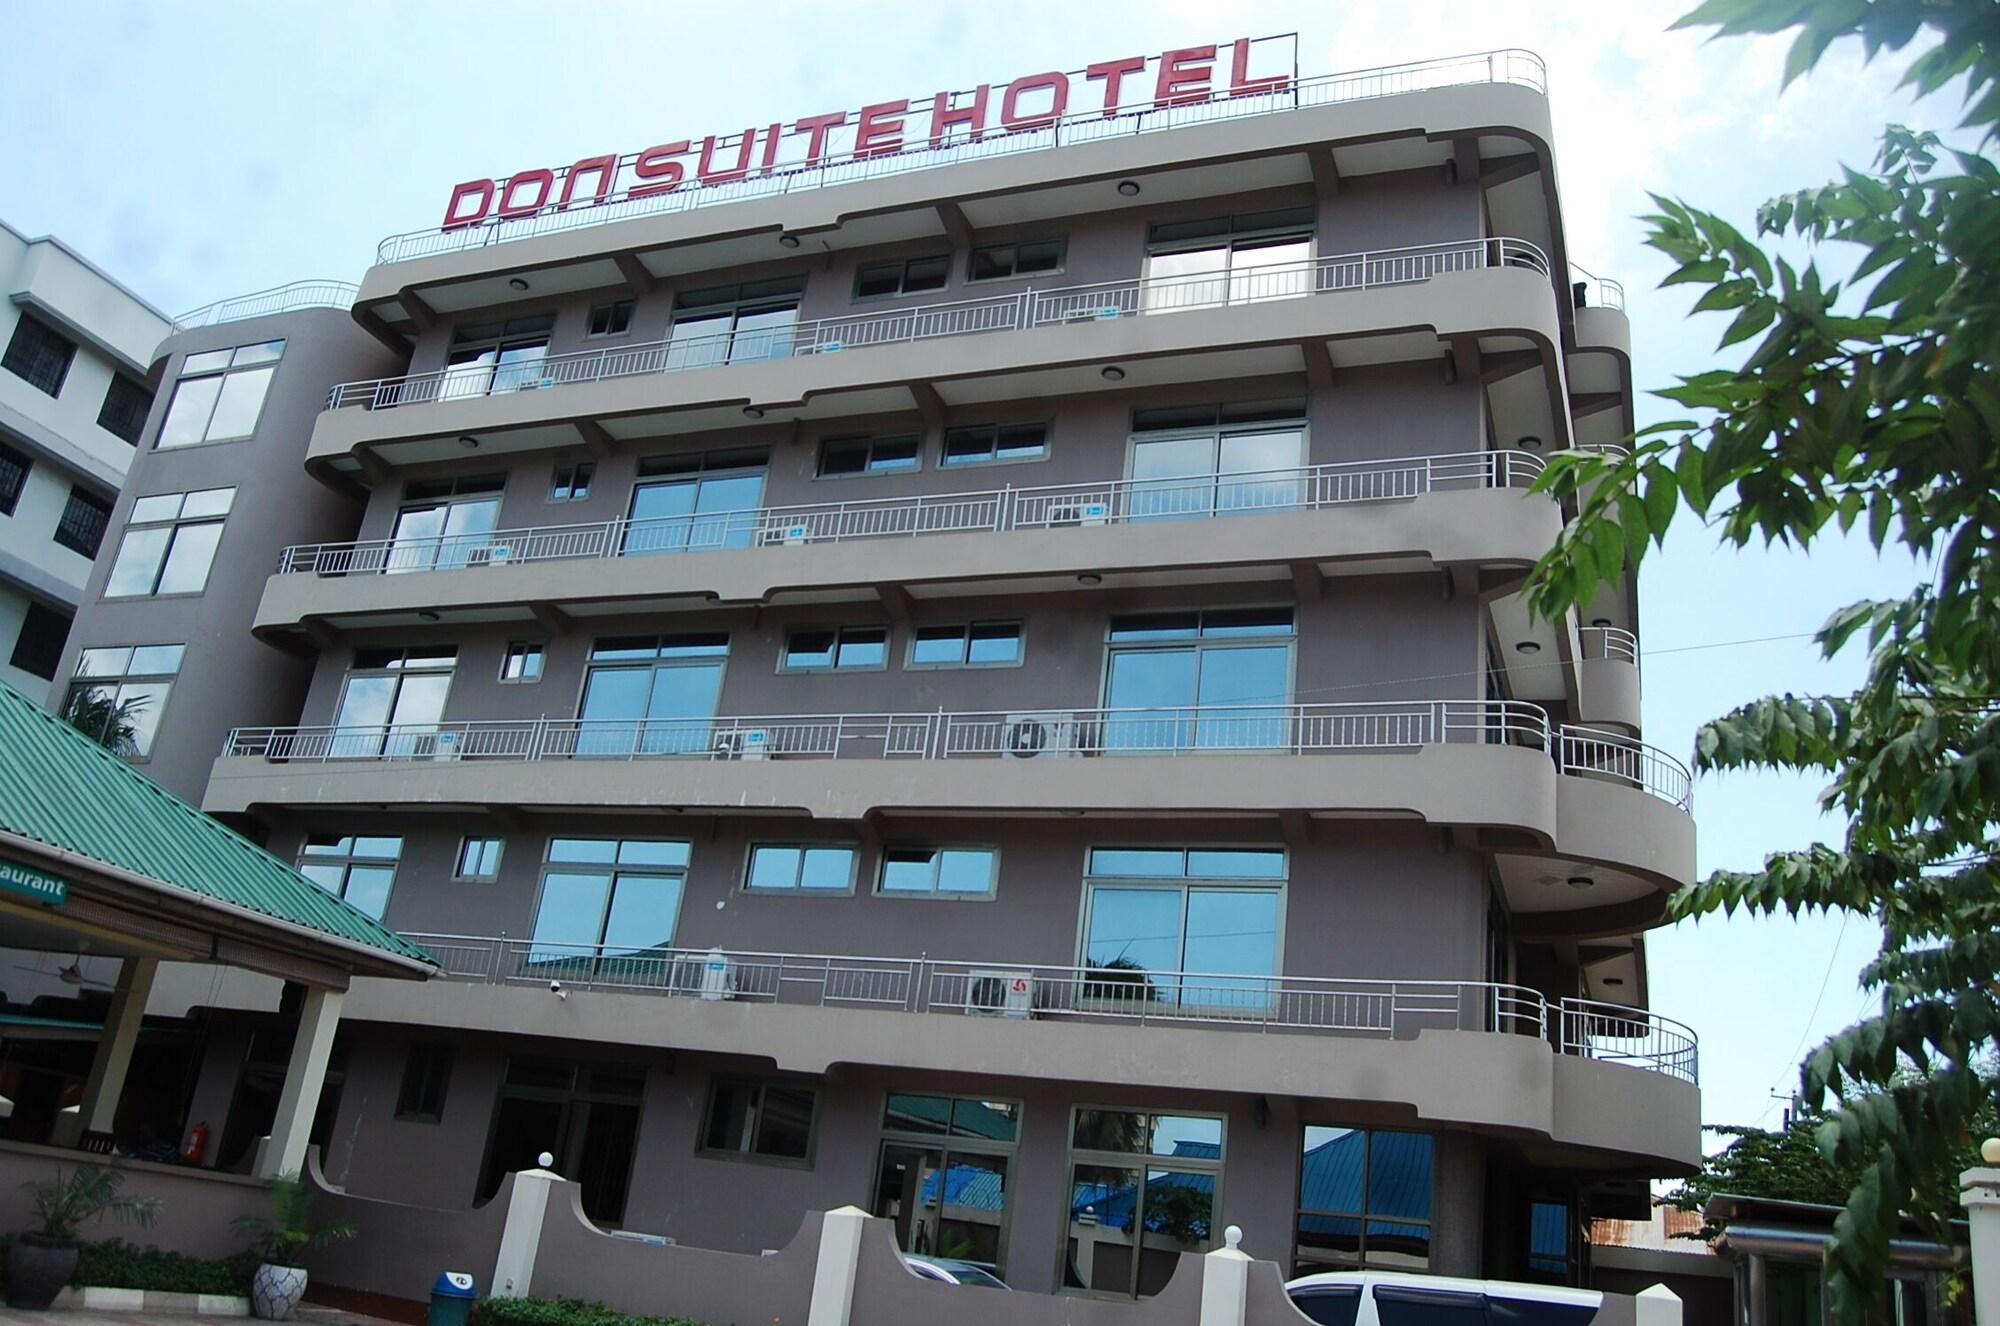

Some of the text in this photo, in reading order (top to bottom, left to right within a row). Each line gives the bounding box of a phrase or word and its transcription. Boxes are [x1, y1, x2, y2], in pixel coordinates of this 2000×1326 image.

[441, 37, 1291, 233] DON SUITE HOTEL
[0, 865, 65, 896] aurant
